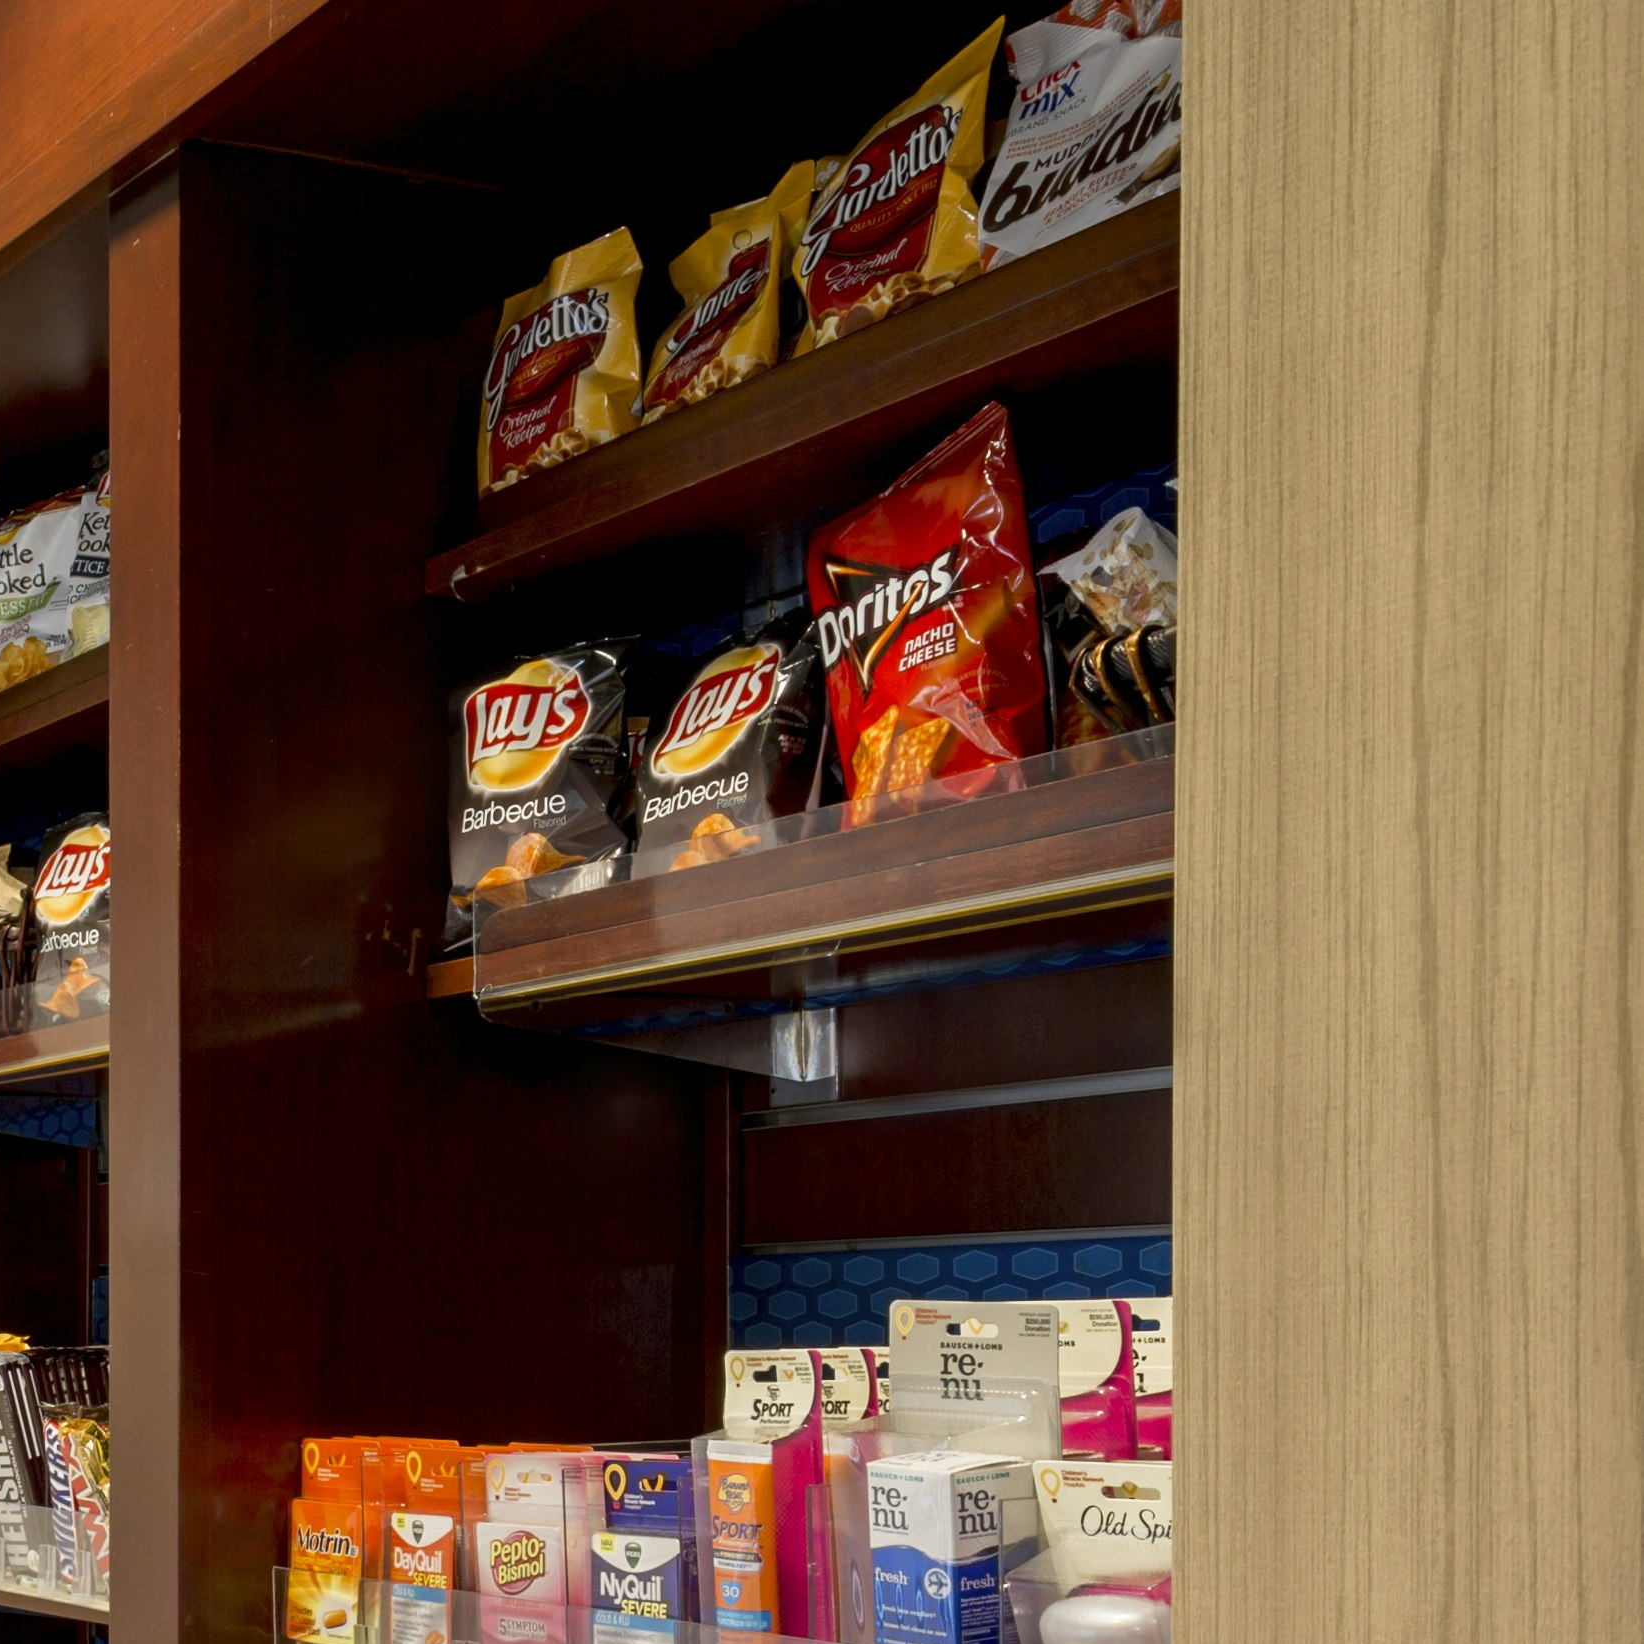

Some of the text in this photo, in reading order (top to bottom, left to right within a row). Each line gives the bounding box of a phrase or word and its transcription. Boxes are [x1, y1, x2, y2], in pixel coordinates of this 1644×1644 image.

[1019, 71, 1081, 121] mix
[982, 81, 1181, 232] buddie
[1034, 124, 1109, 172] MUDDY
[825, 238, 908, 281] Original
[499, 396, 557, 437] Original
[506, 421, 547, 450] Recipe
[818, 550, 957, 669] Doritos
[899, 639, 958, 672] CHEESE
[470, 682, 578, 765] Lay's
[662, 660, 775, 754] Lay's
[461, 794, 566, 834] Barbecue
[642, 771, 750, 824] Barbecue
[533, 814, 567, 830] Flavored
[34, 842, 111, 899] Lay's
[40, 928, 100, 954] arbecue
[940, 1378, 984, 1401] nu
[751, 1398, 794, 1420] SPORT
[822, 1400, 850, 1416] PORT
[46, 1424, 76, 1580] SNICKERS
[712, 1515, 763, 1540] SPORT
[872, 1507, 909, 1531] nu
[959, 1510, 998, 1535] nu
[1080, 1504, 1172, 1545] Old Spi
[295, 1523, 351, 1556] Motrin
[393, 1547, 443, 1577] DayQuil
[498, 1552, 545, 1587] Bismol
[874, 1567, 908, 1586] fresh
[413, 1572, 447, 1590] SEVERE
[599, 1571, 663, 1605] NyQuil
[721, 1584, 739, 1598] 30
[960, 1573, 995, 1591] fresh
[620, 1599, 668, 1620] SEVERE
[506, 1621, 546, 1634] SYMPTOM
